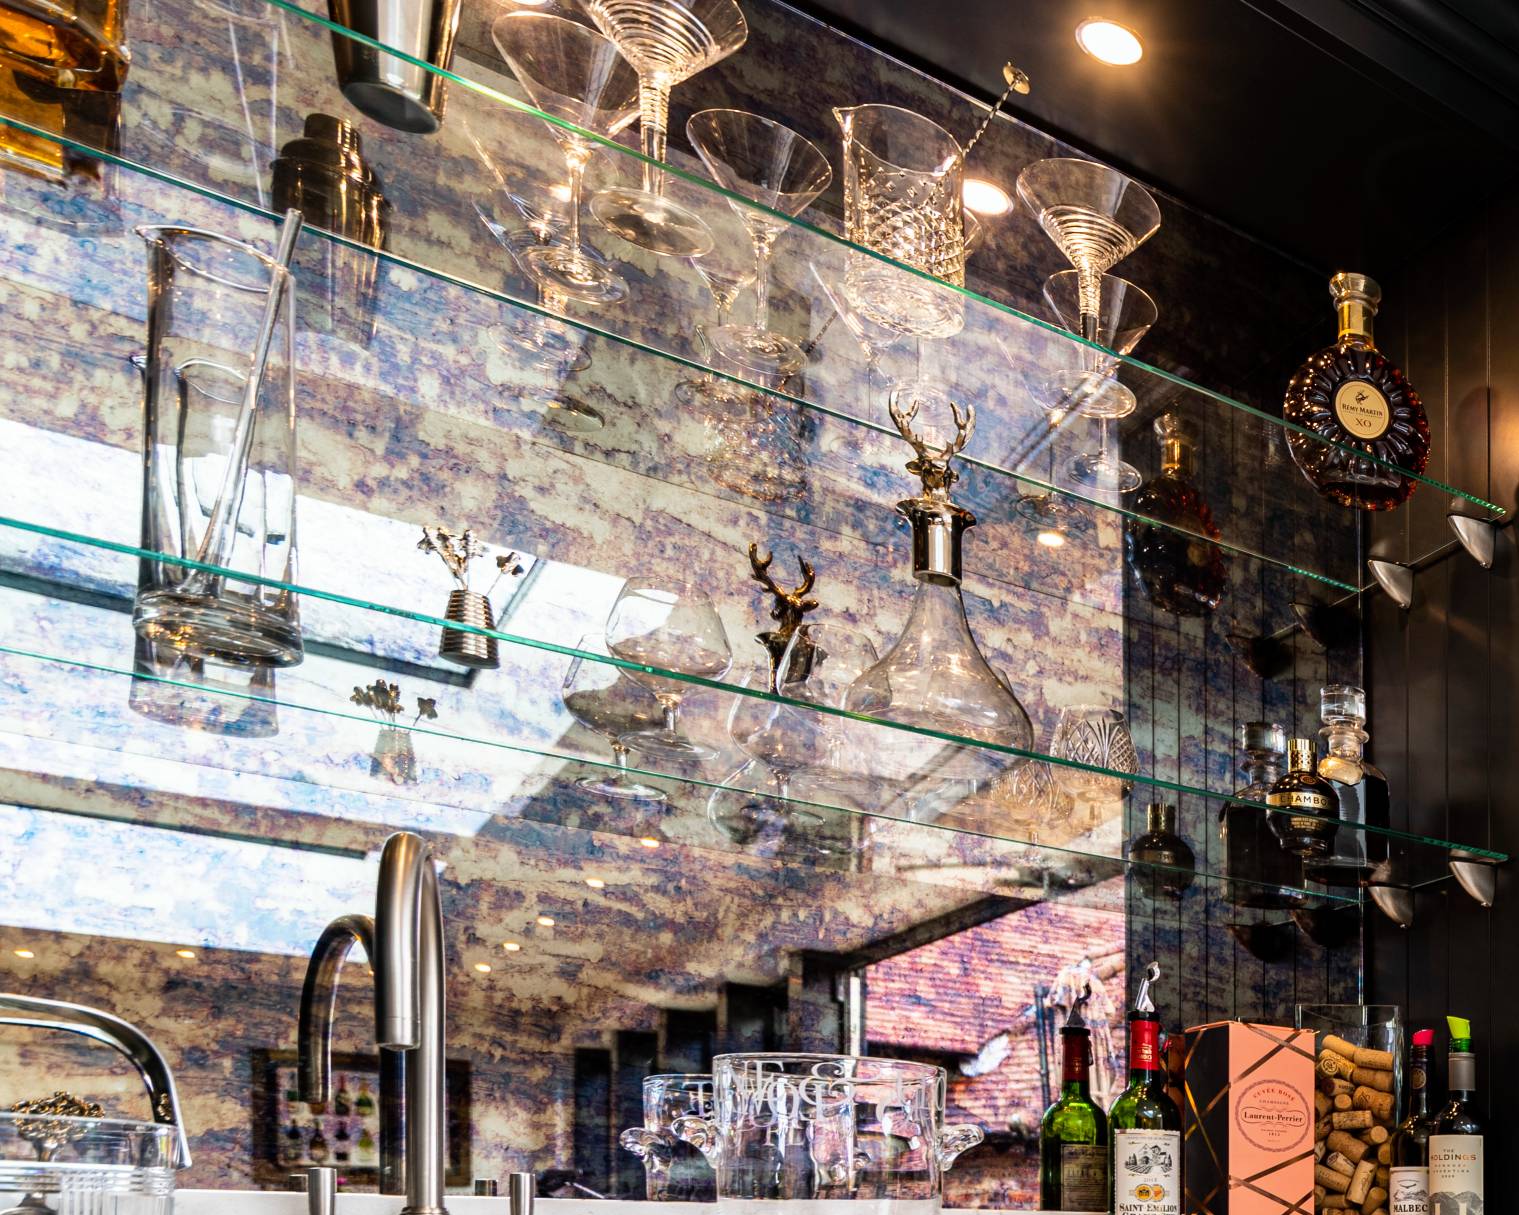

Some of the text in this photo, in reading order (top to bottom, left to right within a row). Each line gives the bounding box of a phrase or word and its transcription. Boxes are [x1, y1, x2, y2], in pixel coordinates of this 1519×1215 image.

[1360, 407, 1383, 417] MARTIN
[1355, 418, 1372, 428] XO
[1280, 795, 1328, 806] CHAMBO
[1244, 1111, 1303, 1123] Laurent-Perrier
[1393, 1203, 1429, 1213] MALBEC
